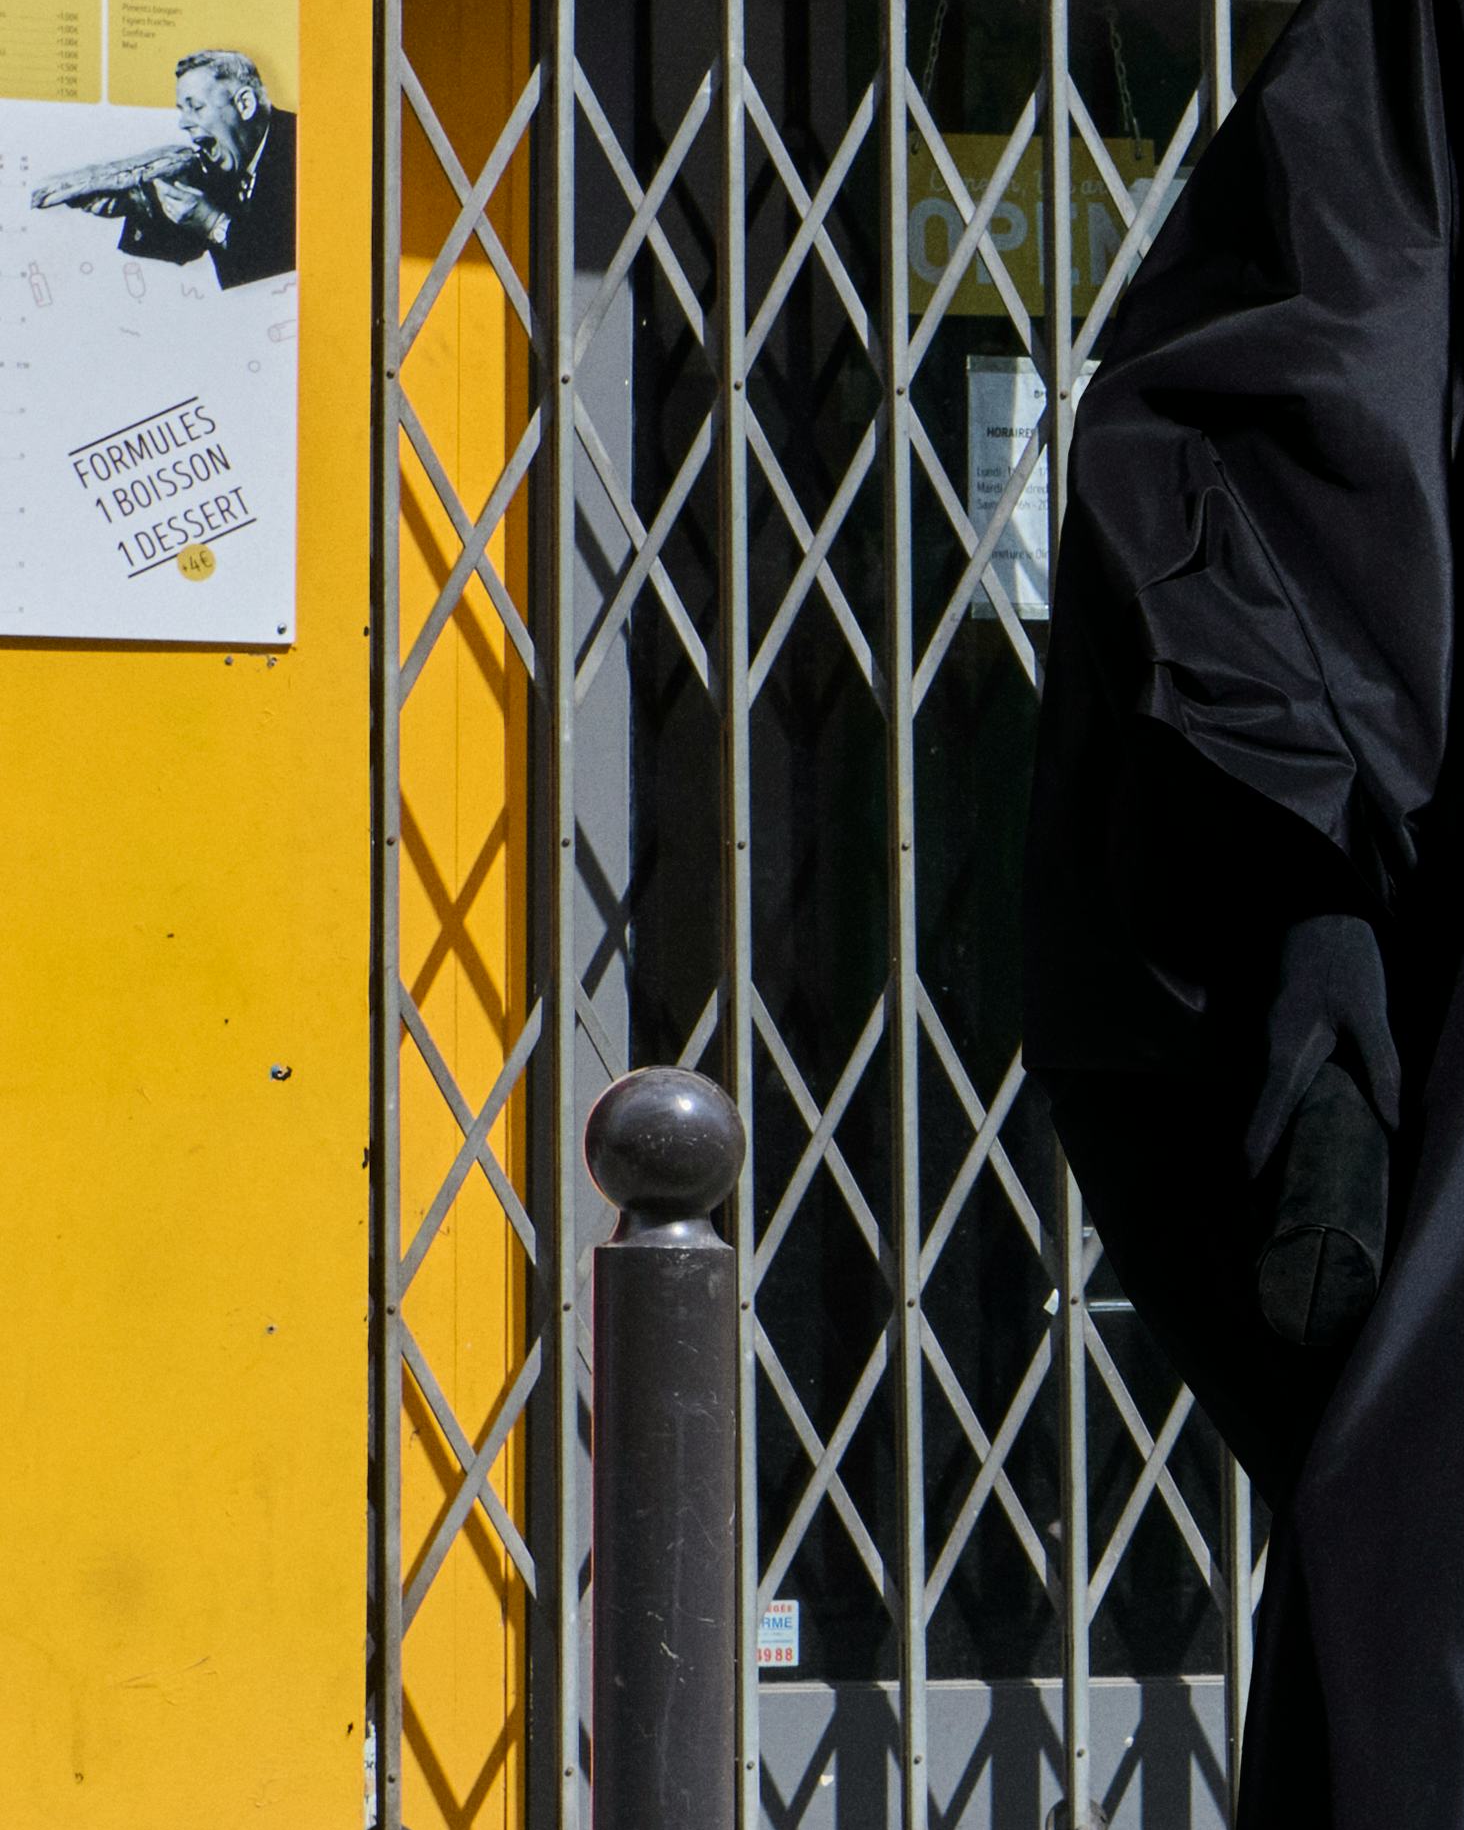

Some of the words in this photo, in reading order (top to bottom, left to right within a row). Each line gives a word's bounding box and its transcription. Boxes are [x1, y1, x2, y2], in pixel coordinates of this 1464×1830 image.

[73, 406, 216, 489] FORMULES
[95, 497, 112, 523] 1
[112, 444, 231, 517] BOISSON
[117, 541, 135, 567] 1
[134, 486, 249, 560] DESSERT
